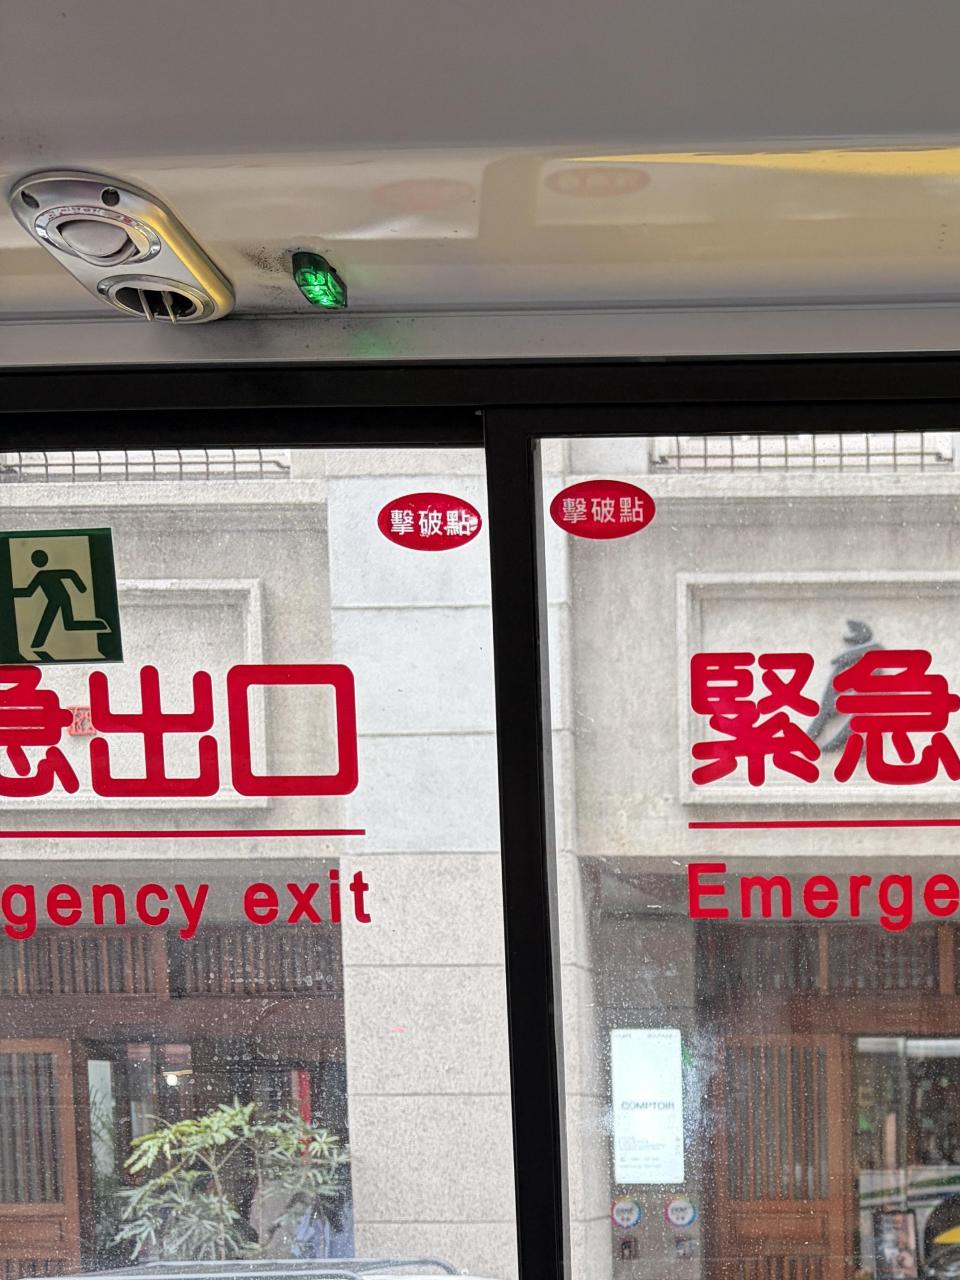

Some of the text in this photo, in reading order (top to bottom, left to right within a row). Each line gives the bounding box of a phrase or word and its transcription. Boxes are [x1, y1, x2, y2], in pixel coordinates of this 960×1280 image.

[390, 509, 472, 536] 擊破點
[562, 496, 645, 524] 擊破點
[0, 868, 372, 941] gency exit
